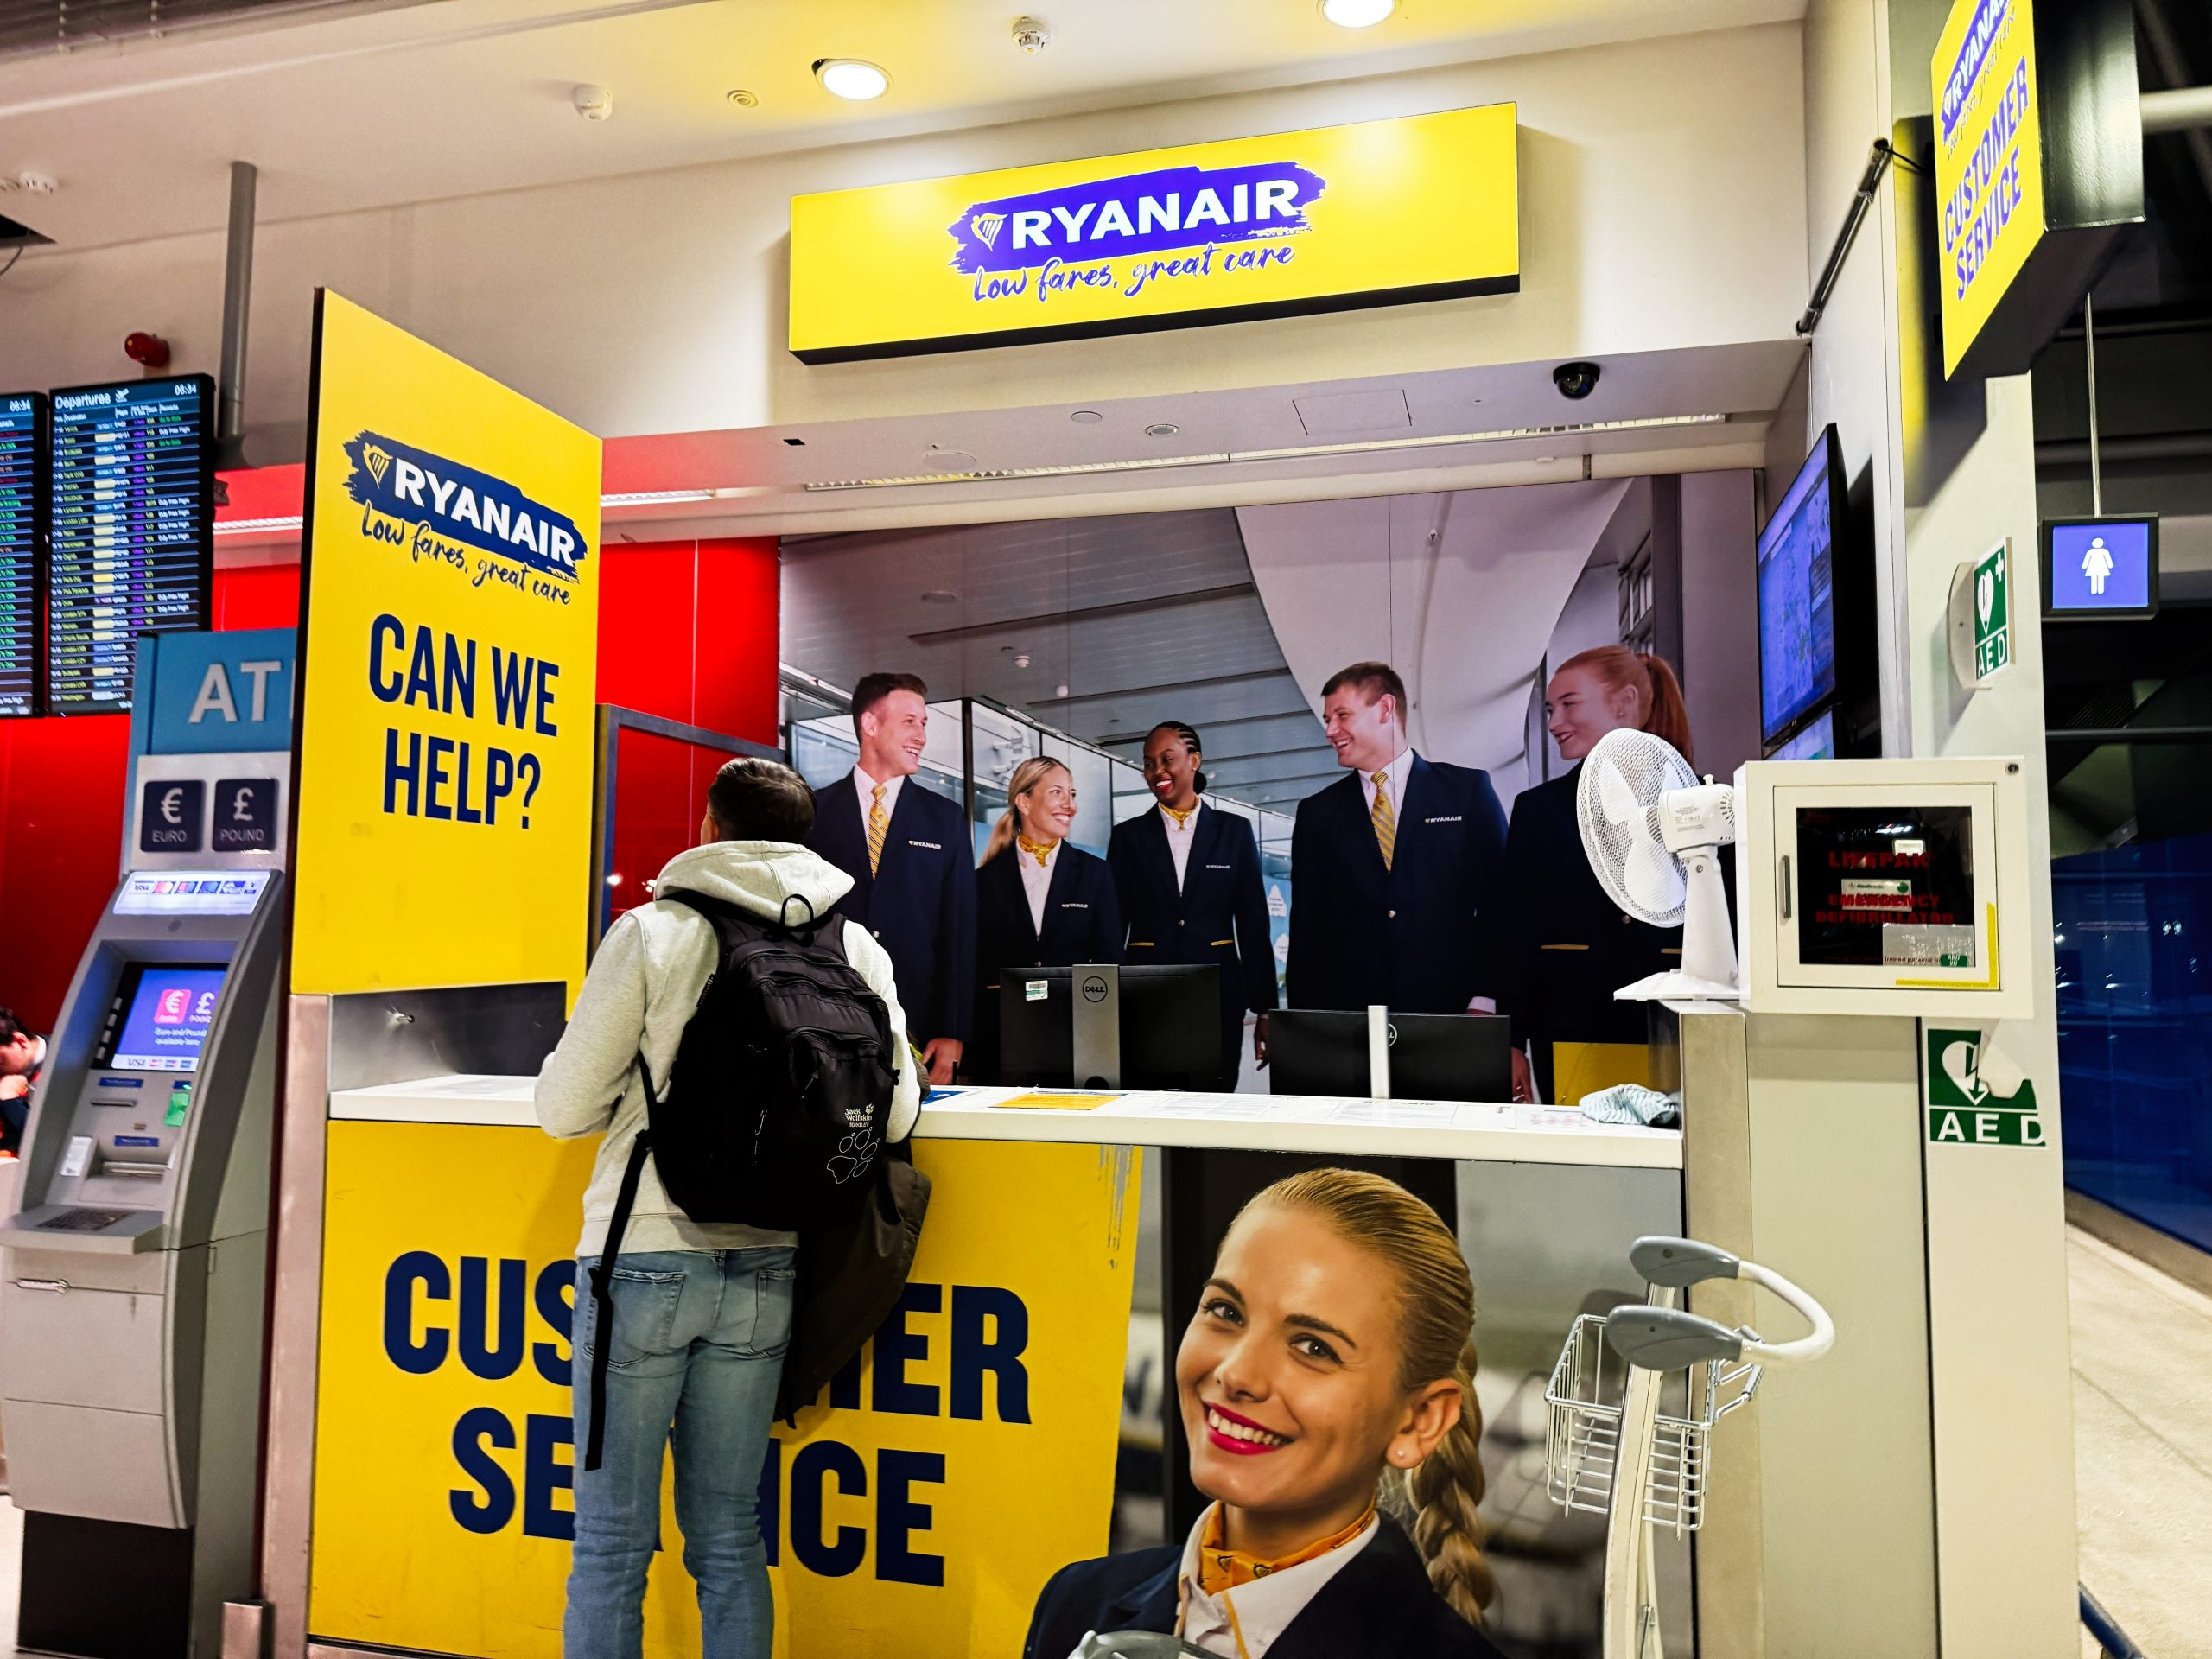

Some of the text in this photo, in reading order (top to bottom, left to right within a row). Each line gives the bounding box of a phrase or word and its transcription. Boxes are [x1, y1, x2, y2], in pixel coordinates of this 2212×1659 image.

[1945, 56, 2028, 254] CUSTOMER
[1011, 178, 1300, 250] RYANAIR
[1957, 143, 2021, 301] SERVICE
[973, 241, 1297, 304] Low fares, great care
[55, 393, 111, 410] Departures
[395, 457, 575, 567] RYANAIR
[361, 503, 571, 607] Low fares, great care
[369, 613, 559, 737] CAN WE
[1978, 632, 2006, 678] AED
[189, 660, 296, 723] AT
[384, 728, 542, 830] HELP?
[152, 830, 187, 843] EURO
[220, 830, 264, 842] POUND
[1430, 815, 1463, 823] RYANAIR
[1828, 851, 1929, 868] LIFEPAK
[1816, 911, 1955, 925] DEFIBRILLATOR
[1828, 893, 1941, 907] EMERGENCY
[1937, 1111, 2046, 1146] AED
[384, 1250, 1032, 1425] CUSER
[448, 1406, 946, 1587] SEICE
